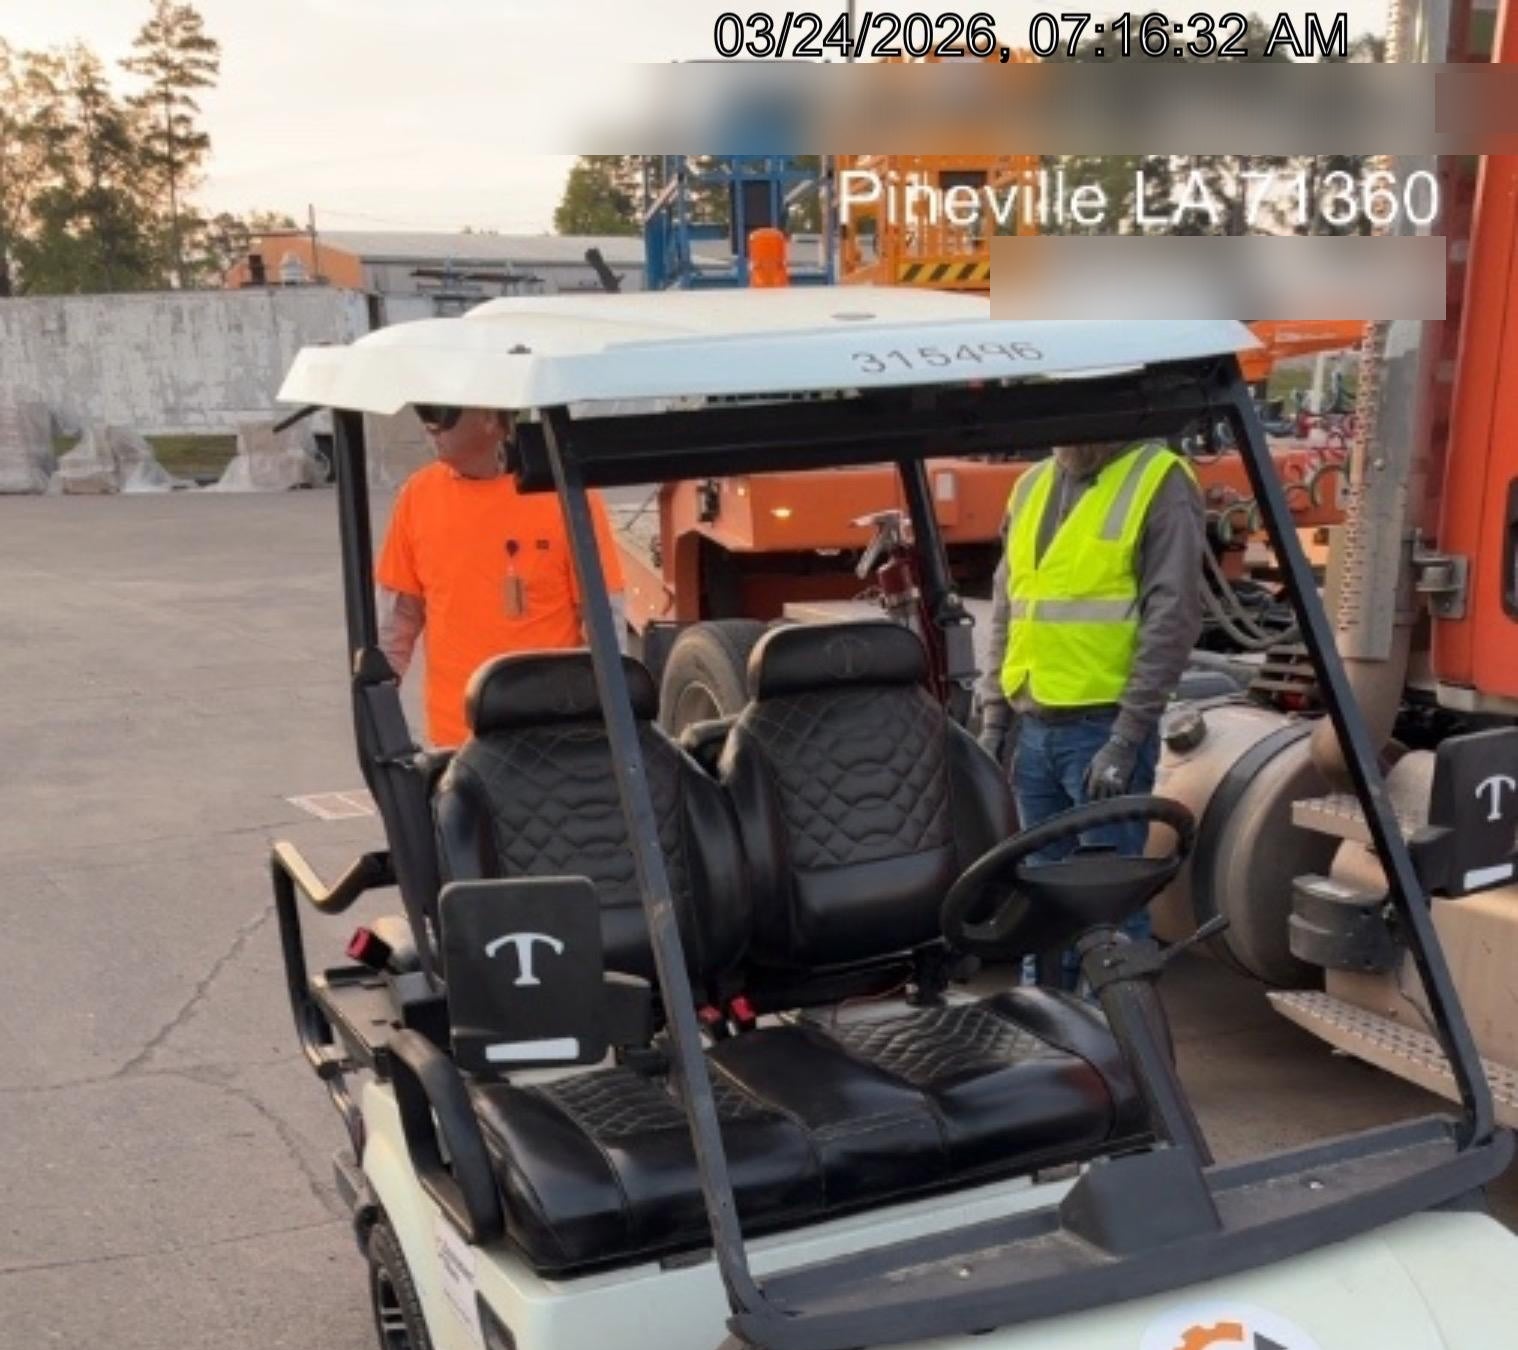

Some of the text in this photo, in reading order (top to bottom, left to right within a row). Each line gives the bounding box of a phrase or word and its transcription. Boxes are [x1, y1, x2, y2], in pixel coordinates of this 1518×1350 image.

[852, 342, 1044, 373] 315496
[1475, 774, 1517, 822] T
[485, 932, 565, 985] T
